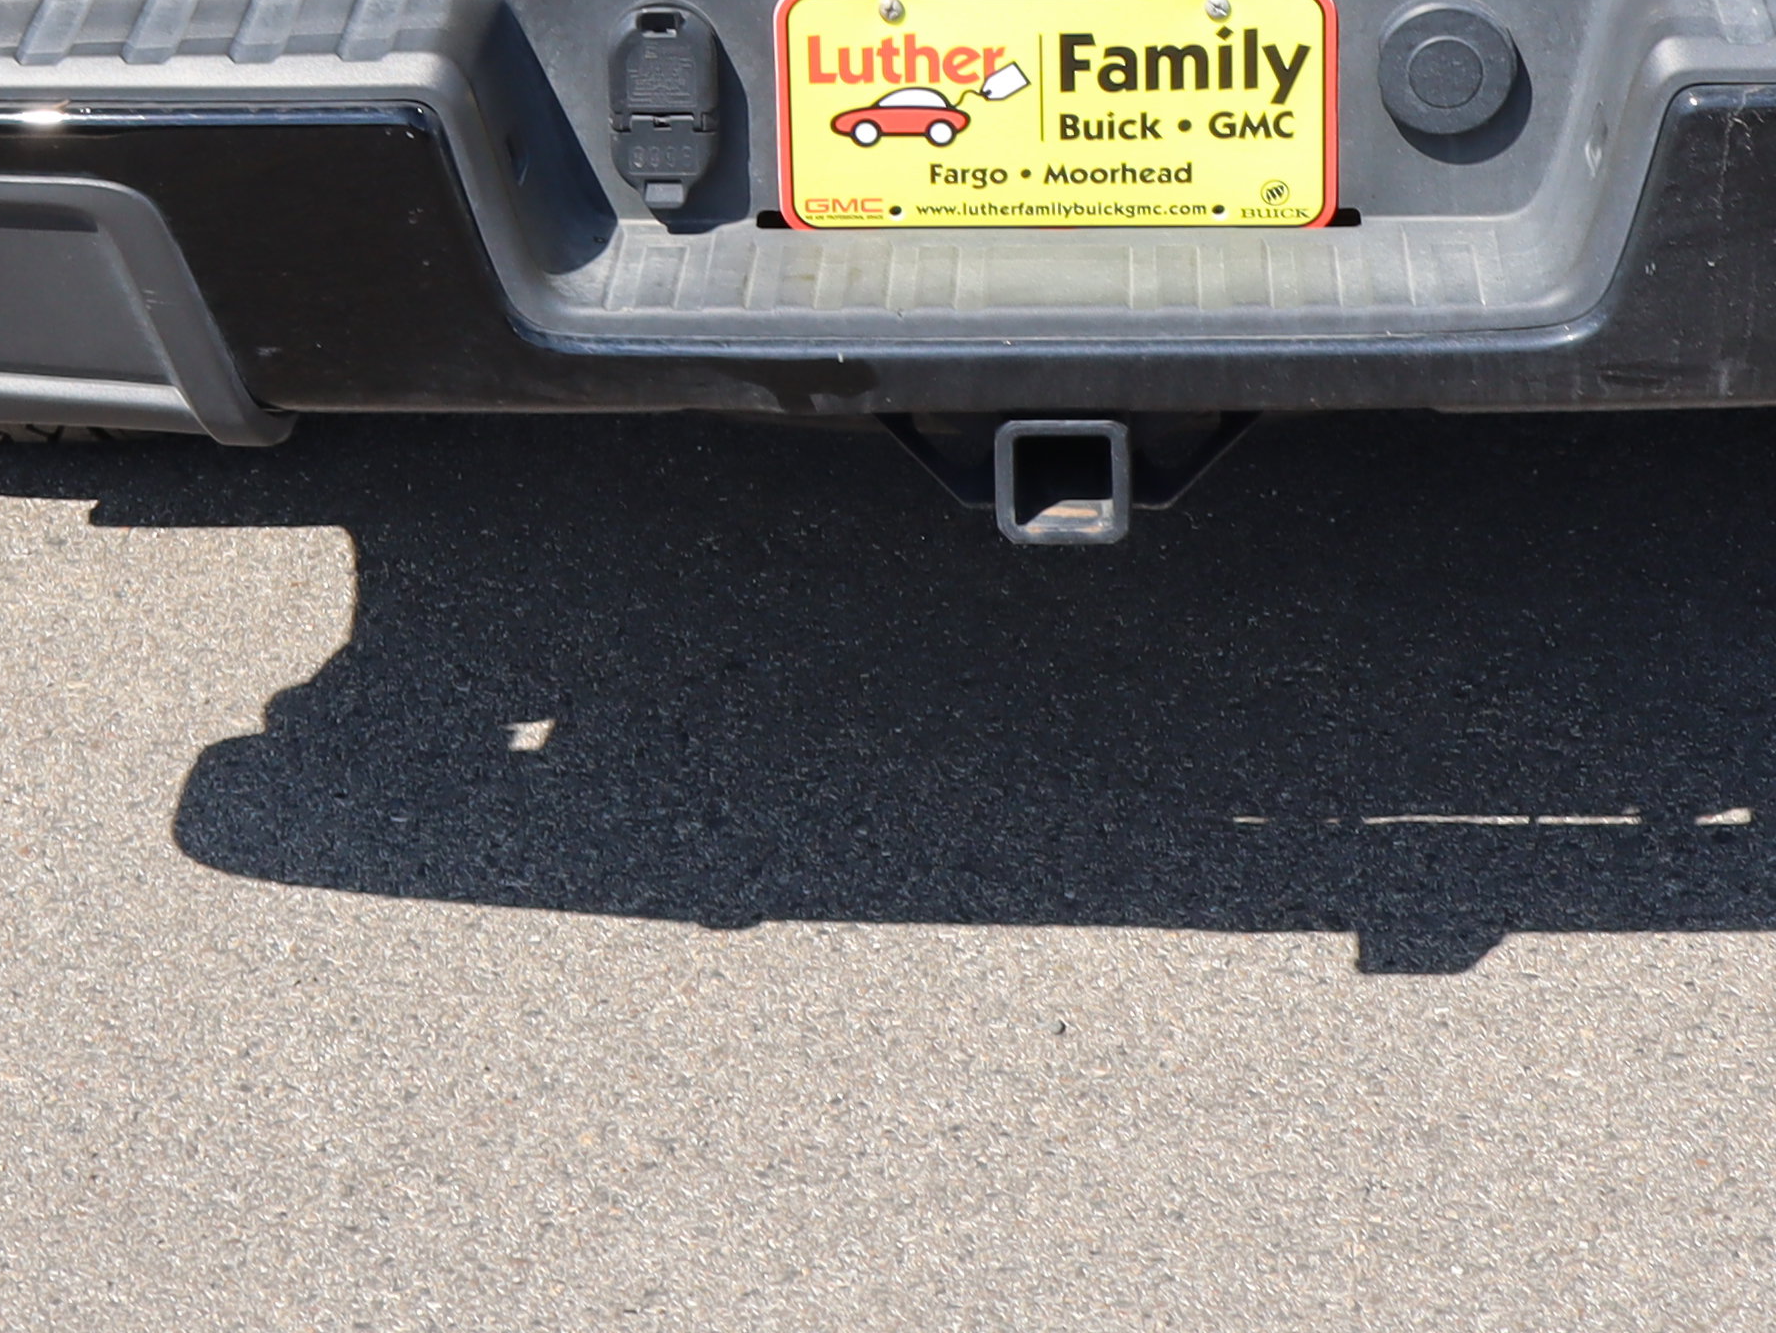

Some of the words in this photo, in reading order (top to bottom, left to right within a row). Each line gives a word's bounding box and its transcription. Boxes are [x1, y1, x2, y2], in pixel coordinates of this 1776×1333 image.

[807, 33, 1006, 86] Luther
[1059, 25, 1311, 106] Family
[1060, 111, 1163, 142] Buick
[1208, 111, 1295, 141] GMC
[930, 164, 1009, 190] Fargo
[1044, 162, 1193, 186] Moorhead
[805, 198, 884, 214] GMC
[916, 202, 1207, 219] www.lutherfamilybuickgmc.com
[1241, 207, 1311, 219] BUICK
